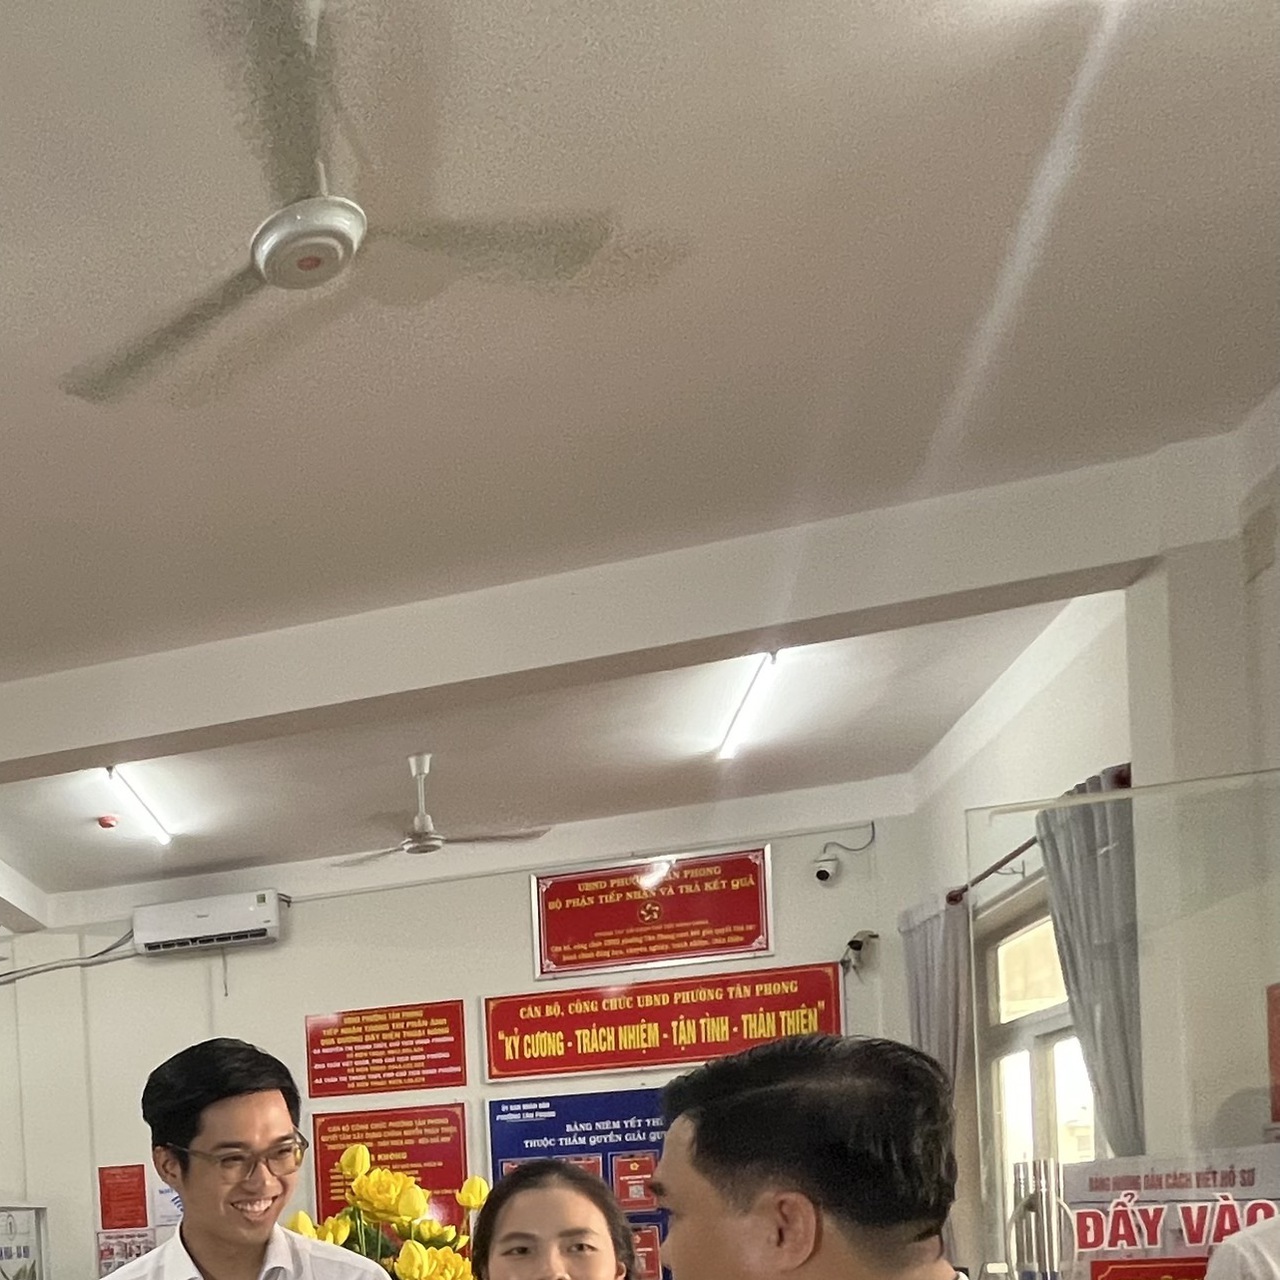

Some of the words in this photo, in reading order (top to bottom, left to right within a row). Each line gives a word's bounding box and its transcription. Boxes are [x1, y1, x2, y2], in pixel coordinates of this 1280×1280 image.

[577, 881, 607, 892] UBND
[683, 866, 721, 878] PHONG
[598, 890, 623, 904] TIẾP
[660, 885, 675, 895] VÀ
[704, 878, 727, 891] KẾT
[730, 874, 756, 890] QUẢ
[520, 1004, 541, 1019] CÁN
[545, 1002, 565, 1017] BỘ,
[568, 999, 598, 1014] CÔNG
[602, 994, 633, 1011] CHỨC
[637, 993, 670, 1008] UBND
[673, 985, 724, 1004] PHƯỜNG
[727, 984, 751, 999] TÂN
[755, 980, 798, 996] PHONG
[523, 1031, 564, 1059] CƯƠNG
[575, 1023, 615, 1054] TRÁCH
[618, 1018, 660, 1054] NHIỆM
[671, 1014, 697, 1051] TẬN
[699, 1012, 730, 1043] TÌNH
[741, 1007, 776, 1039] THÂN
[565, 1120, 593, 1133] BẢNG
[623, 1115, 643, 1128] YẾT
[524, 1136, 556, 1149] THUỘC
[559, 1133, 587, 1146] THẨM
[589, 1130, 622, 1146] QUYỀN
[624, 1130, 647, 1142] GIẢI
[1239, 1167, 1256, 1187] SƠ
[1076, 1191, 1167, 1250] ĐẨY
